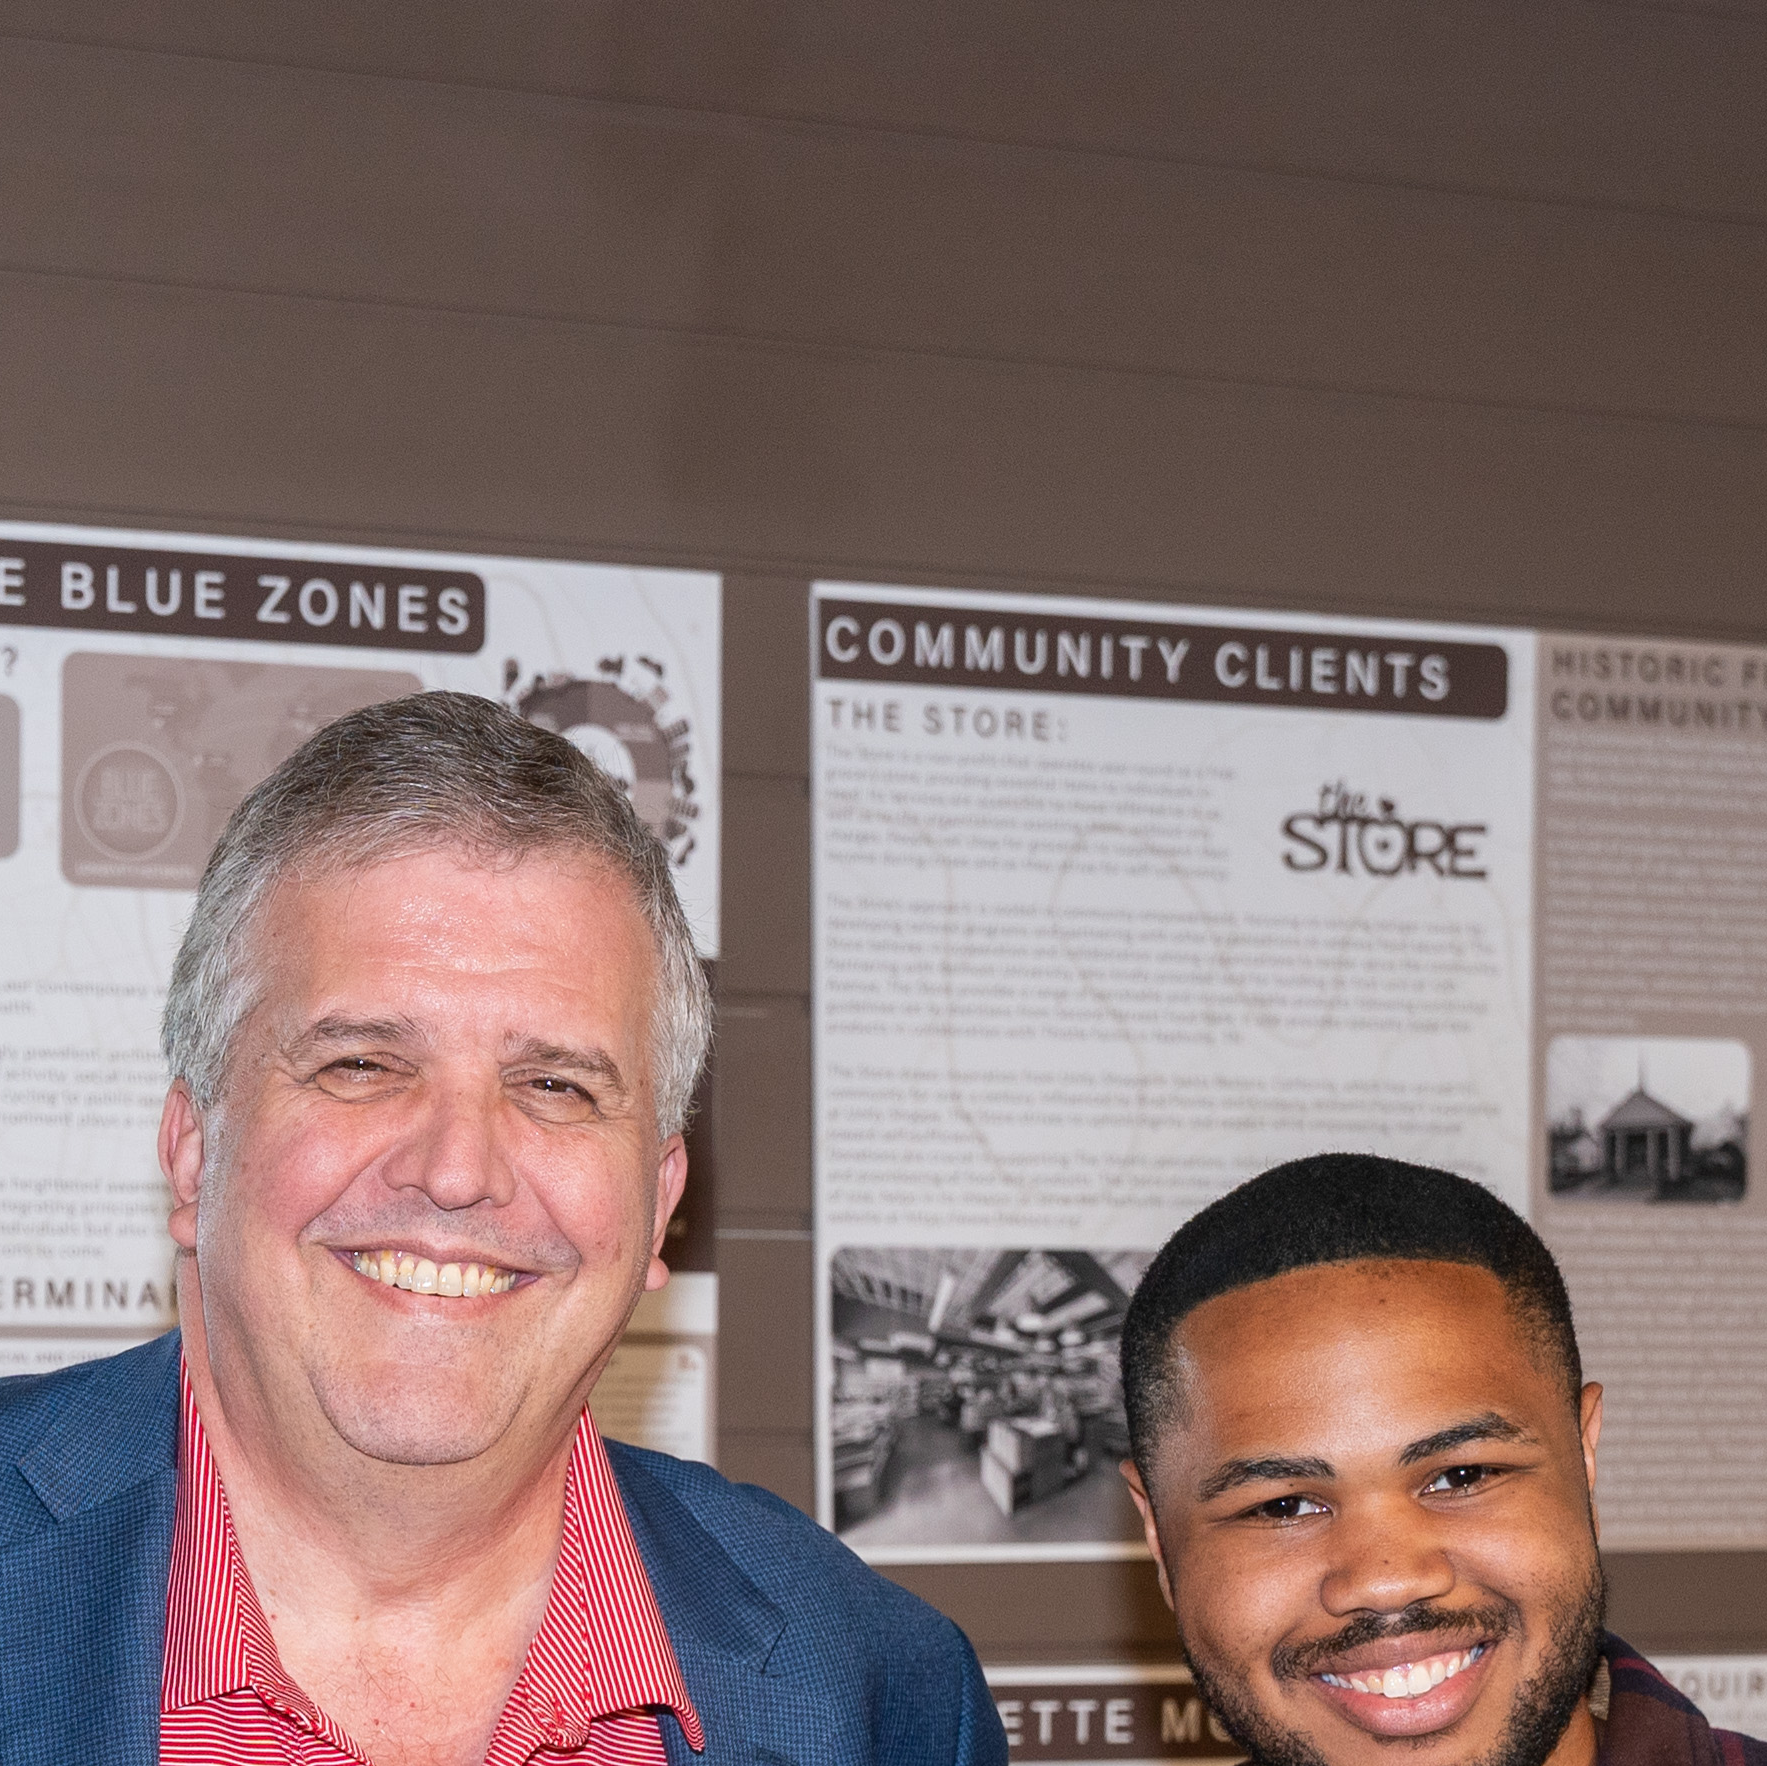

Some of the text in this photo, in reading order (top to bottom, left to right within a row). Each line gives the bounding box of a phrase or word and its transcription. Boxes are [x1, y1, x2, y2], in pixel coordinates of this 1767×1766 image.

[60, 562, 227, 619] BLUE
[256, 575, 472, 635] ZONES
[825, 616, 1451, 701] COMMUNITY CLIENTS
[1552, 649, 1726, 686] HISTORIC
[827, 698, 1068, 742] THE STORE:
[1281, 812, 1489, 880] STORE
[1002, 1697, 1135, 1747] ETTE
